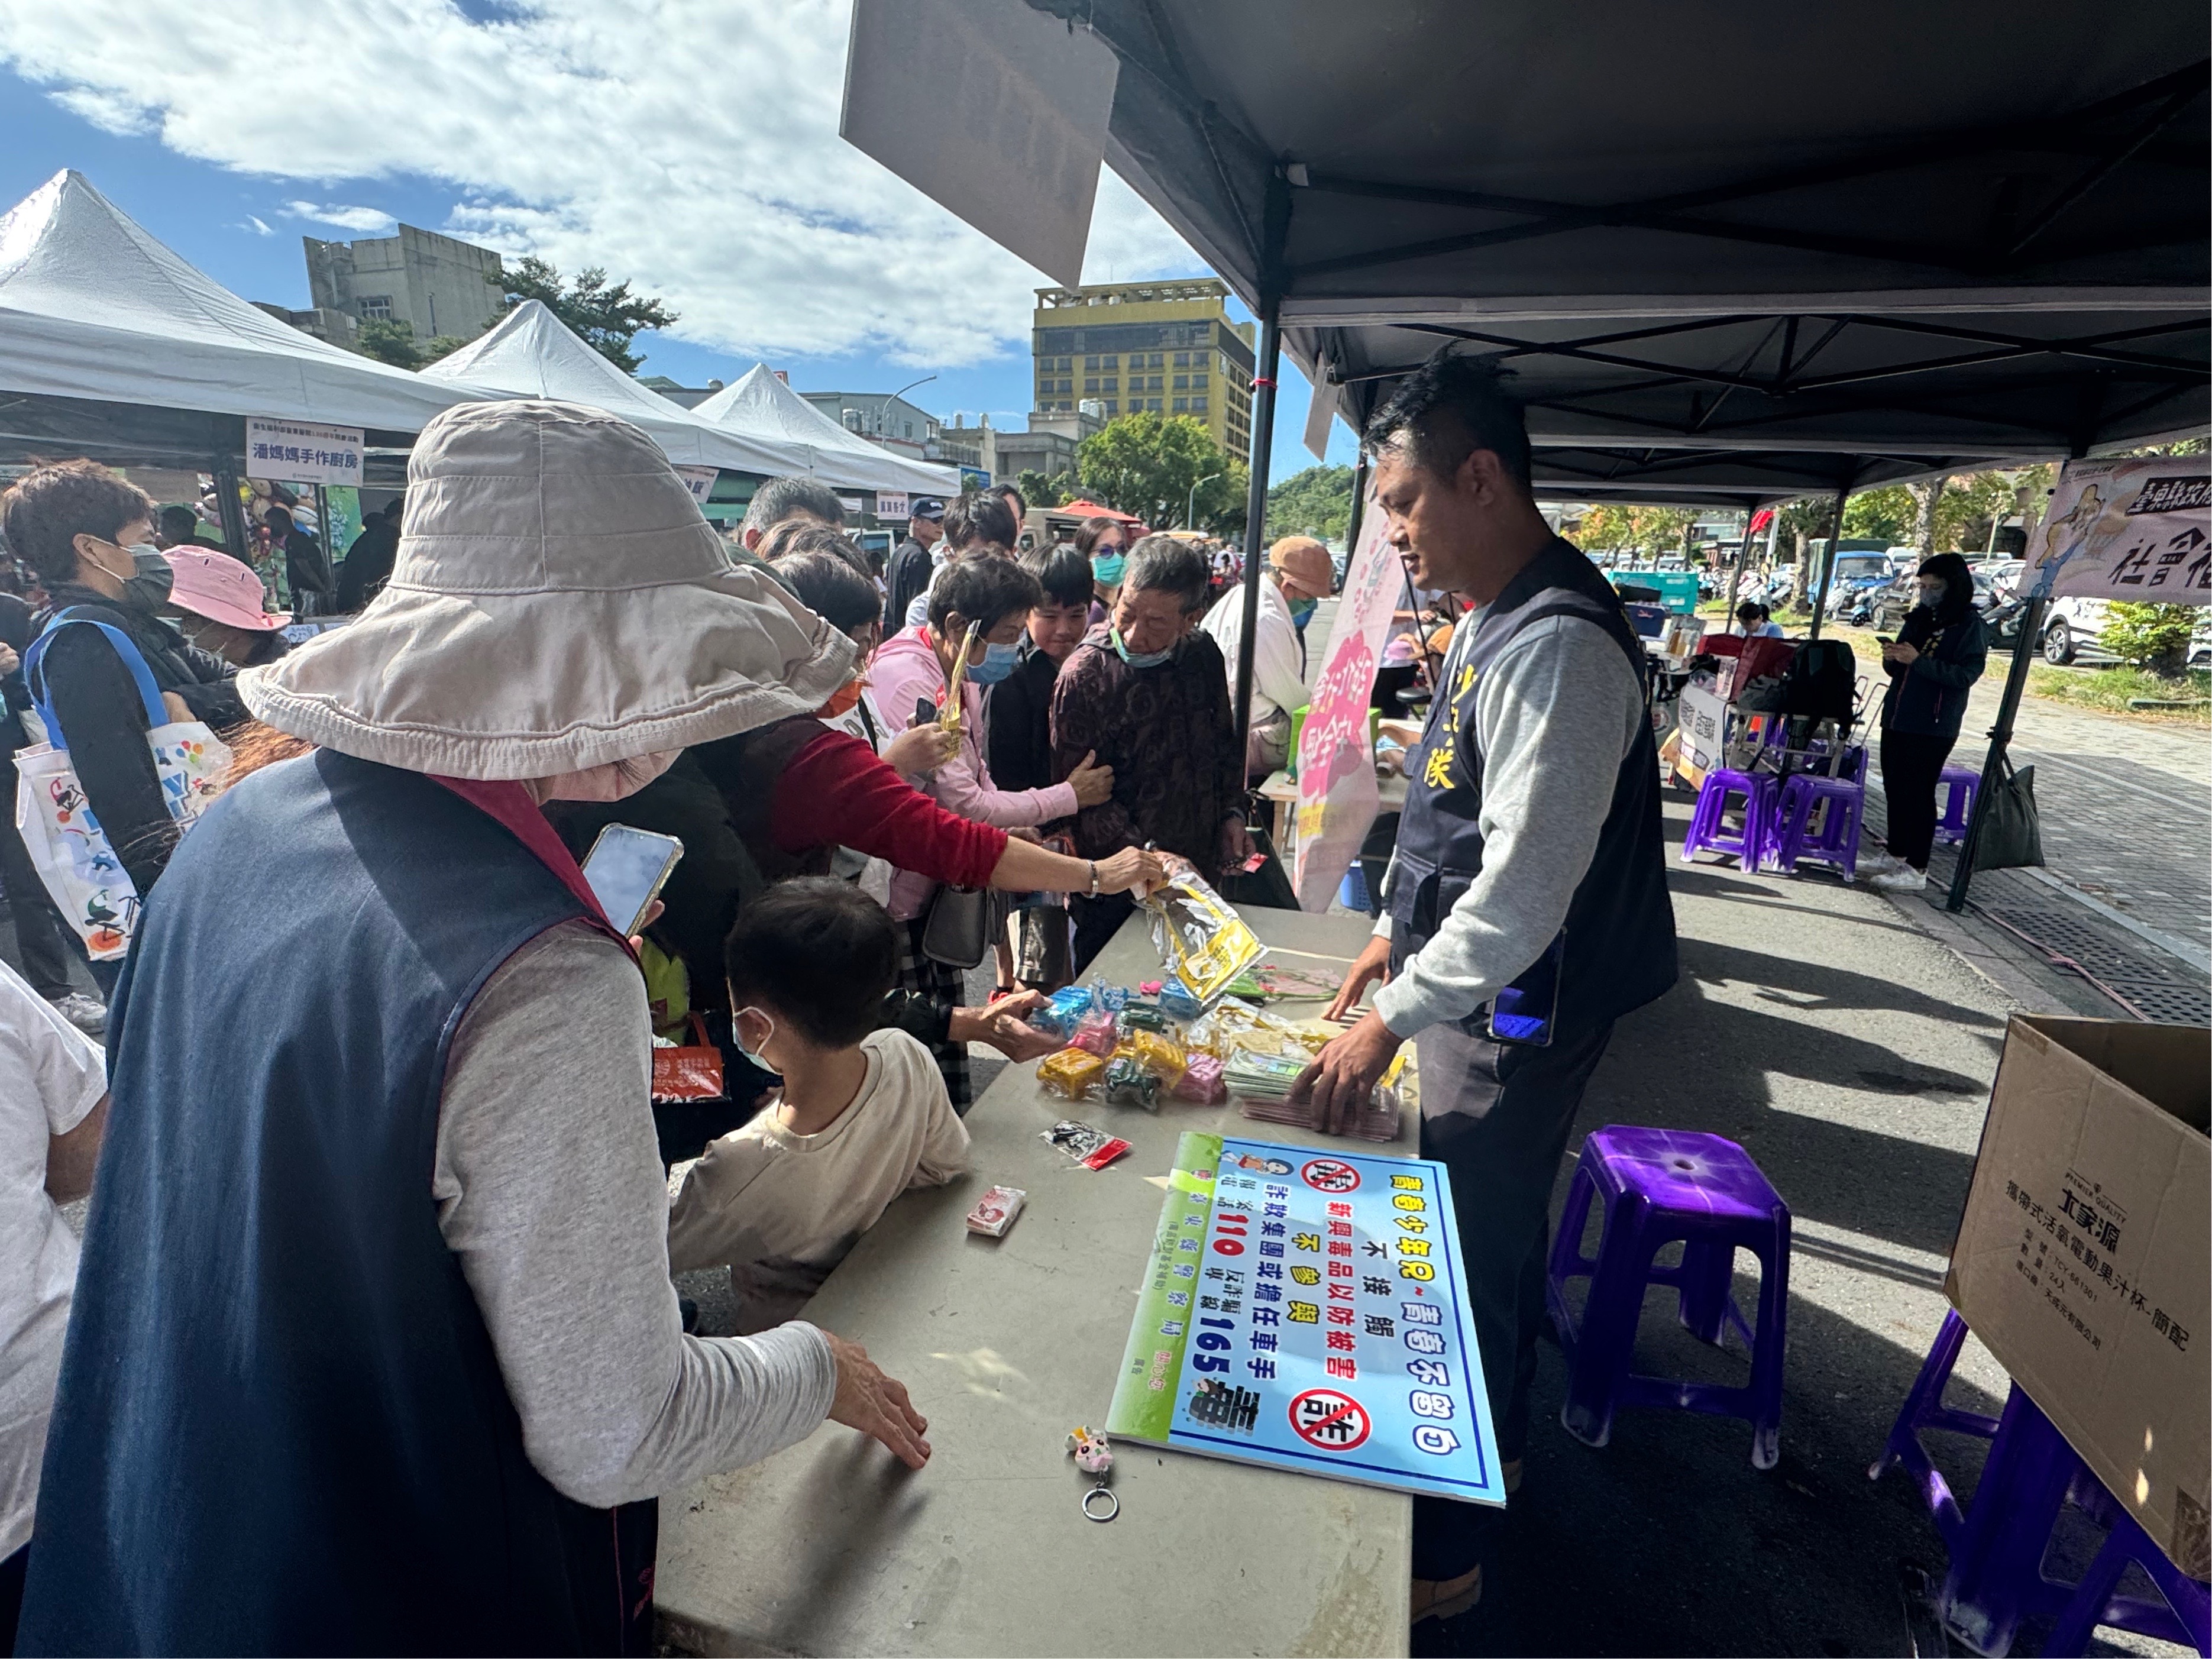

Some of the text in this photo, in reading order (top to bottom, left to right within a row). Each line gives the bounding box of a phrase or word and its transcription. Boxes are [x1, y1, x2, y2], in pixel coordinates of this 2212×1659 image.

[253, 442, 358, 468] 潘媽媽手作廚房
[1212, 1213, 1249, 1256] 110
[2065, 1172, 2126, 1224] PREMIER QUALITY
[1247, 1184, 1291, 1380] 詐欺集團或擔任車手
[1287, 1233, 1321, 1325] 不參與
[1325, 1201, 1358, 1380] 新興毒品以防被害
[1362, 1241, 1394, 1338] 不接觸
[1192, 1317, 1236, 1374] 165
